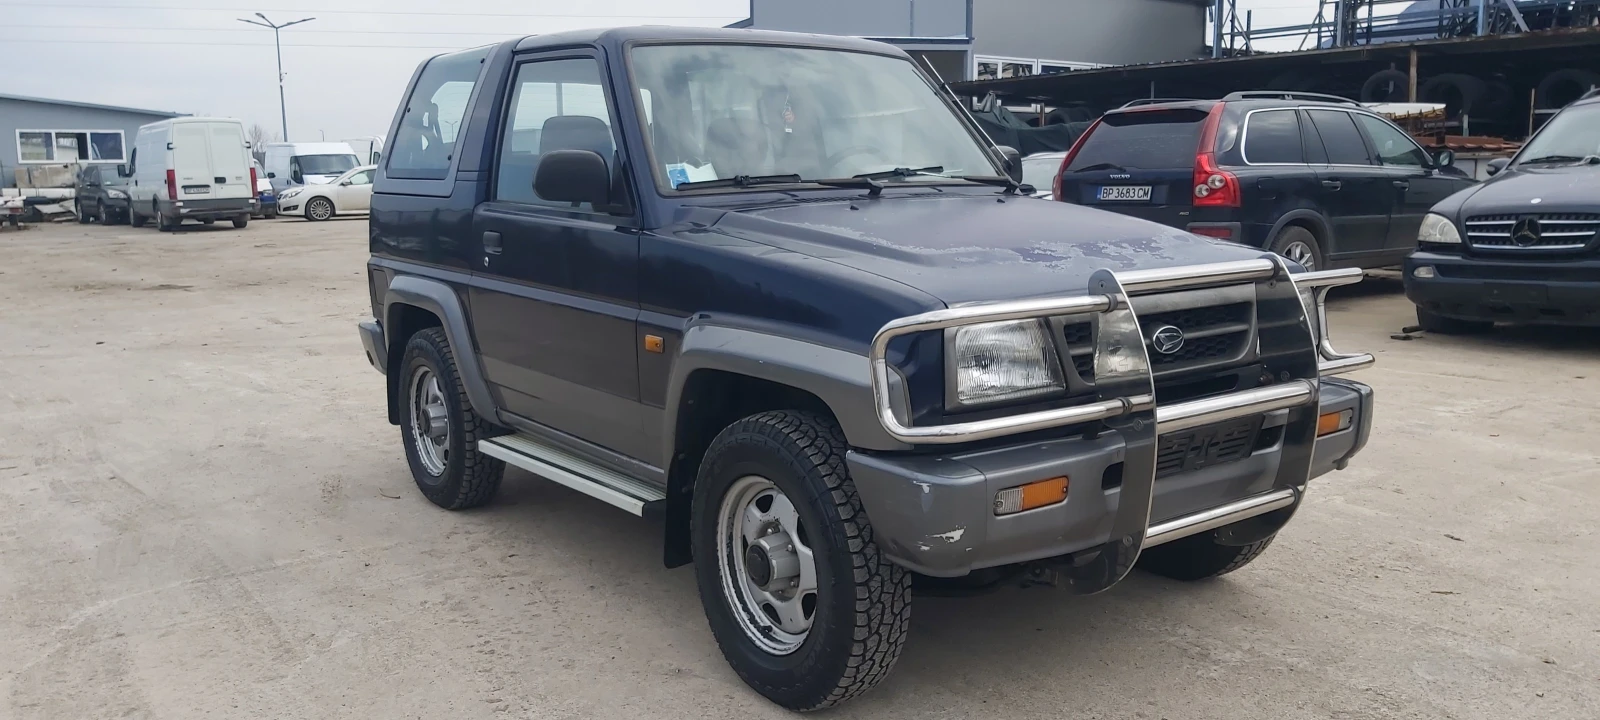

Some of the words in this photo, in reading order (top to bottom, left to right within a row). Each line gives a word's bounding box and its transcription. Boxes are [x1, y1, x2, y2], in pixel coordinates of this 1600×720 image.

[1102, 187, 1114, 199] BP
[1114, 187, 1136, 199] 3683
[1137, 187, 1150, 199] CM
